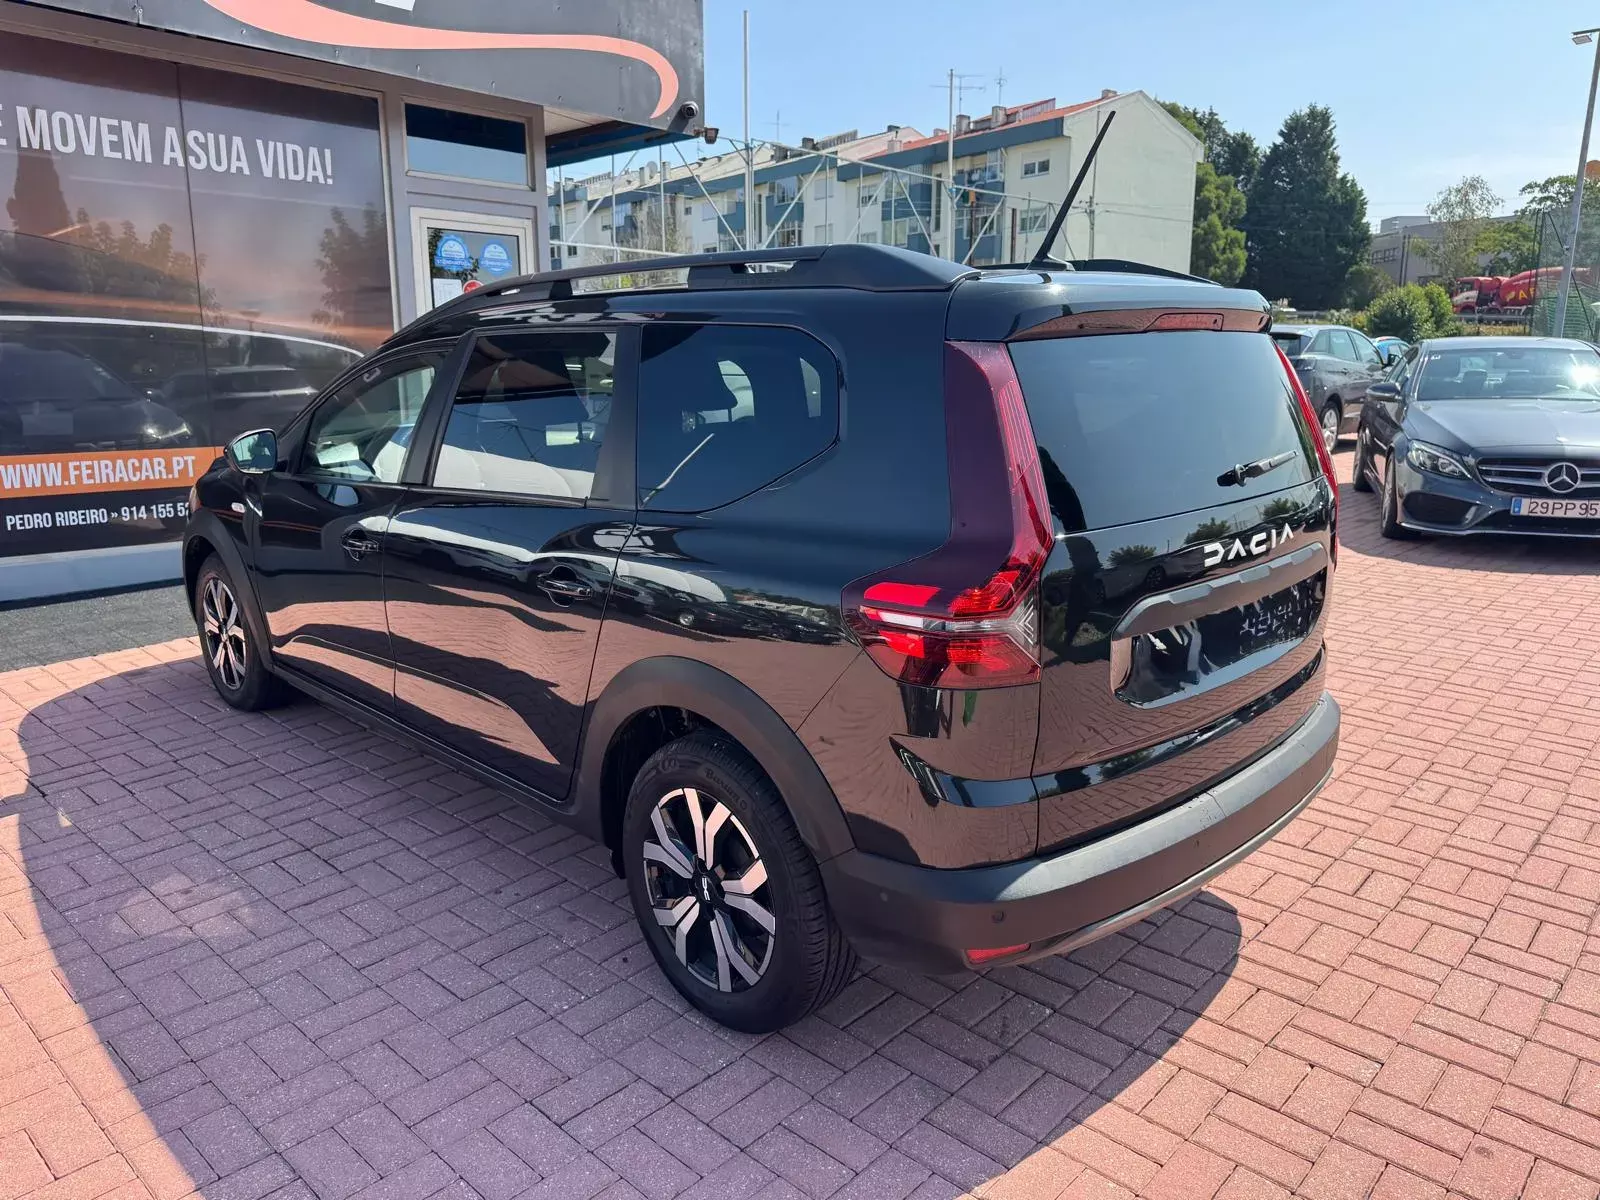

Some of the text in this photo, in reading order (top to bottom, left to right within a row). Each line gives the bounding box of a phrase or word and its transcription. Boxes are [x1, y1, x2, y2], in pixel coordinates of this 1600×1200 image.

[16, 105, 152, 163] MOVEM
[256, 139, 334, 185] VIDA!
[0, 455, 196, 489] WWW.FEIRACAR.PT
[6, 512, 52, 531] PEDRO
[55, 508, 108, 528] RIBEIRO
[122, 505, 147, 522] 914
[150, 503, 173, 519] 155
[1204, 523, 1294, 567] DACIA
